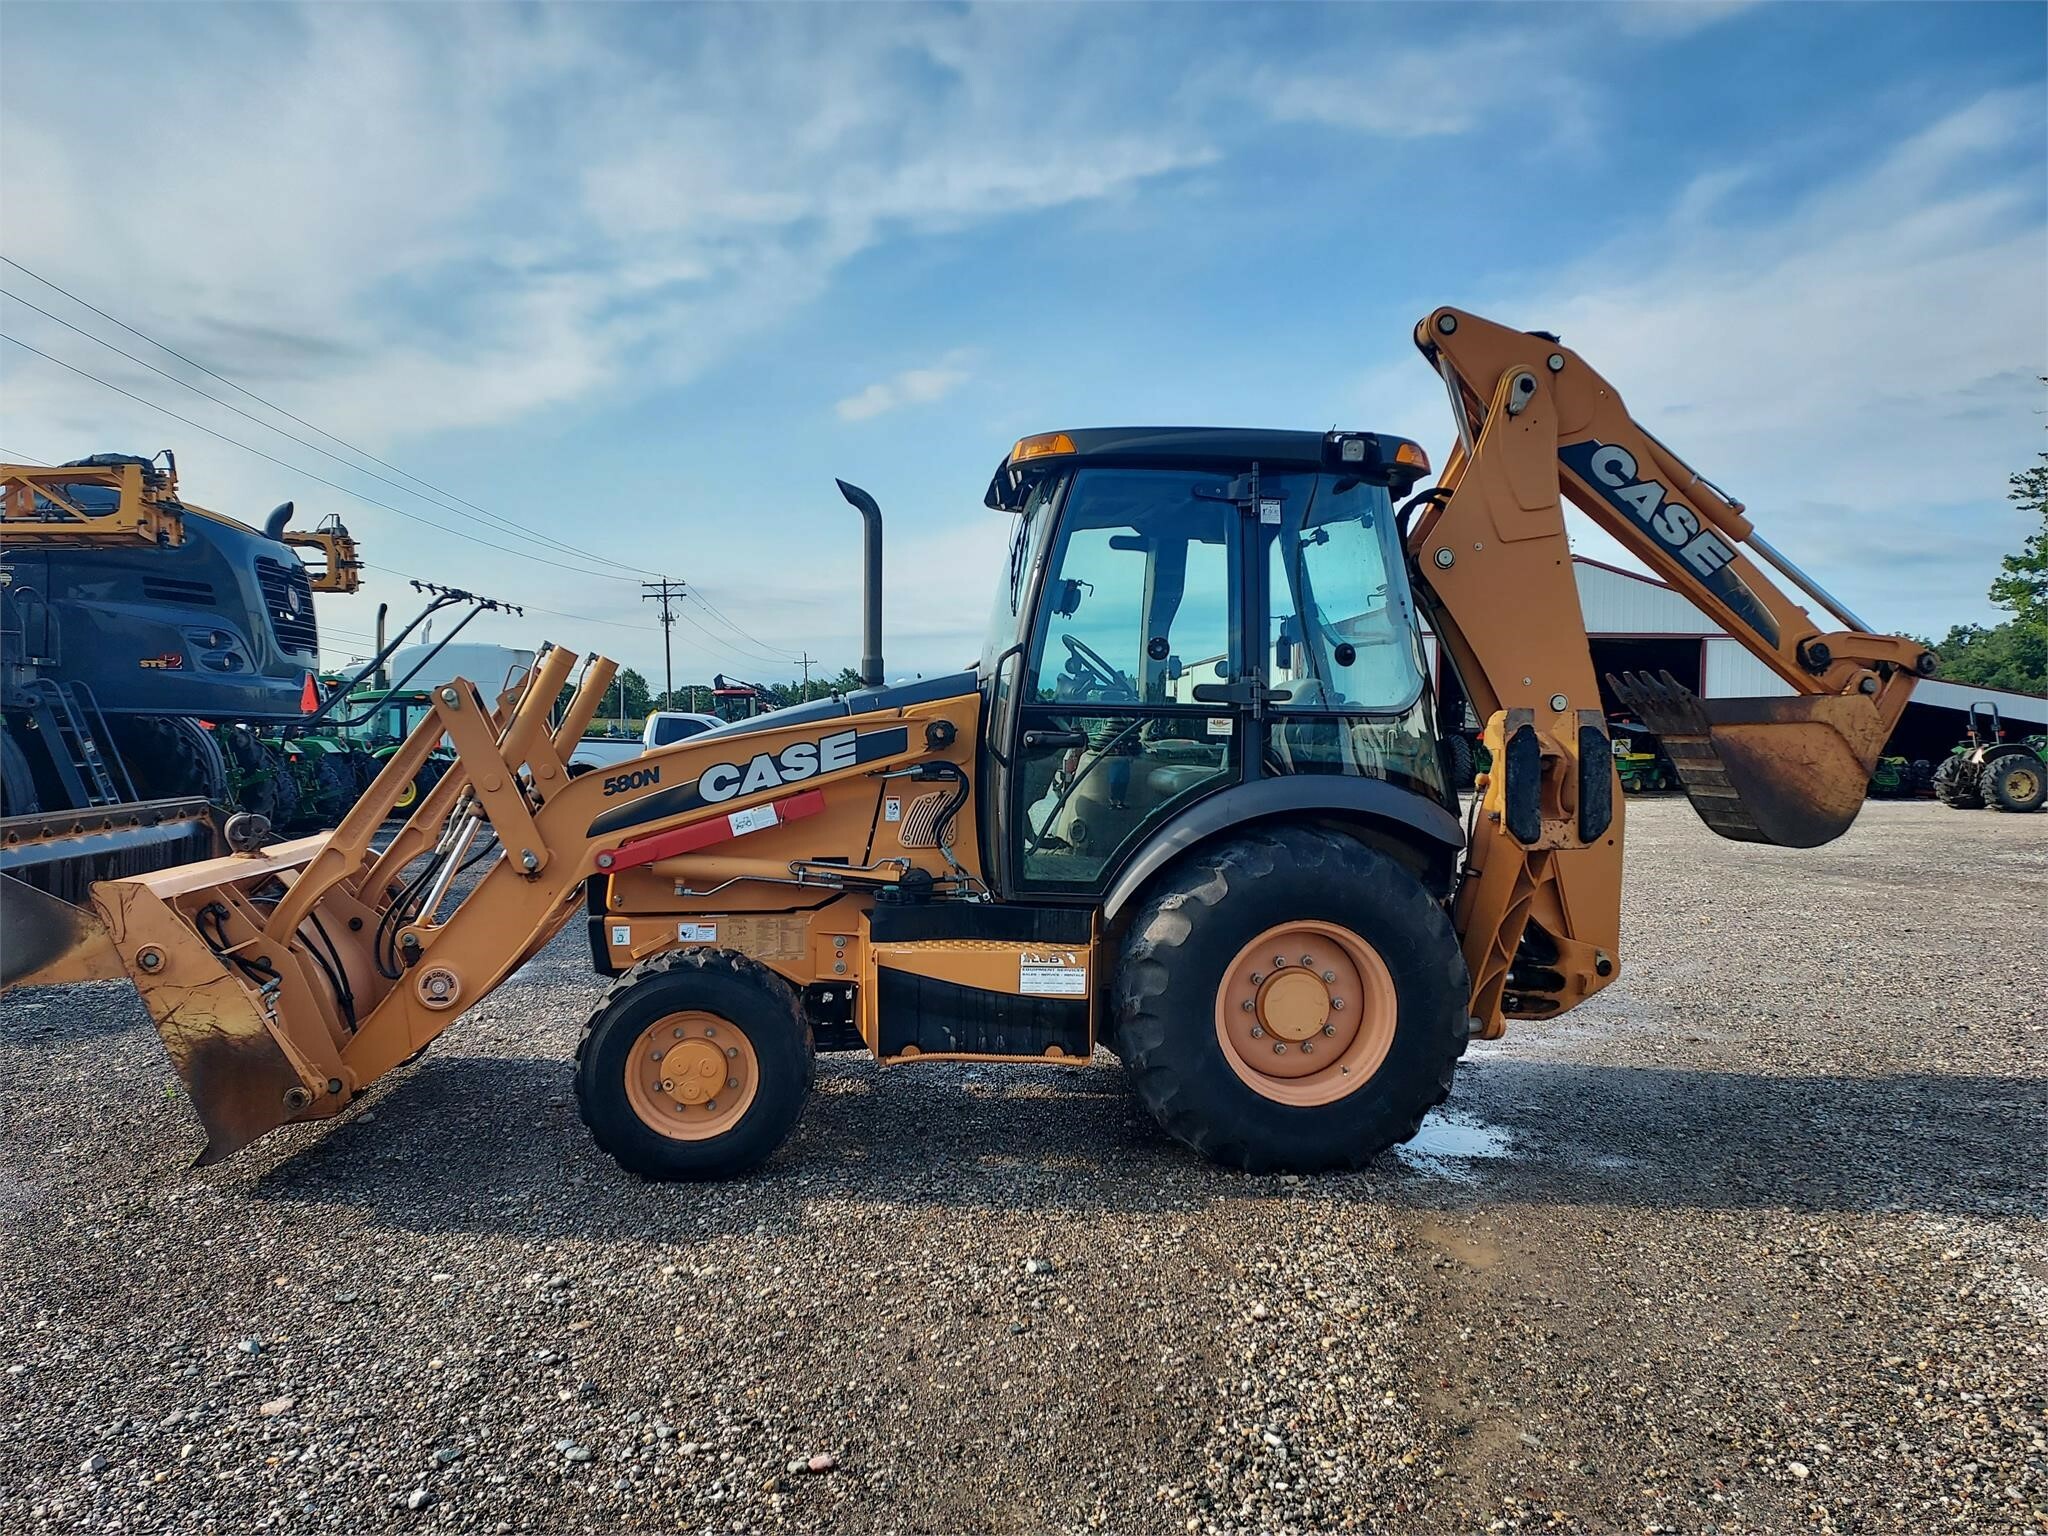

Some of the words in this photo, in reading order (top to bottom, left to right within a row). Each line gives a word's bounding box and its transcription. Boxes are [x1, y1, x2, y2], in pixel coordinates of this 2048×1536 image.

[1591, 444, 1737, 577] CASE
[603, 766, 660, 796] 580N
[699, 730, 857, 802] CASE
